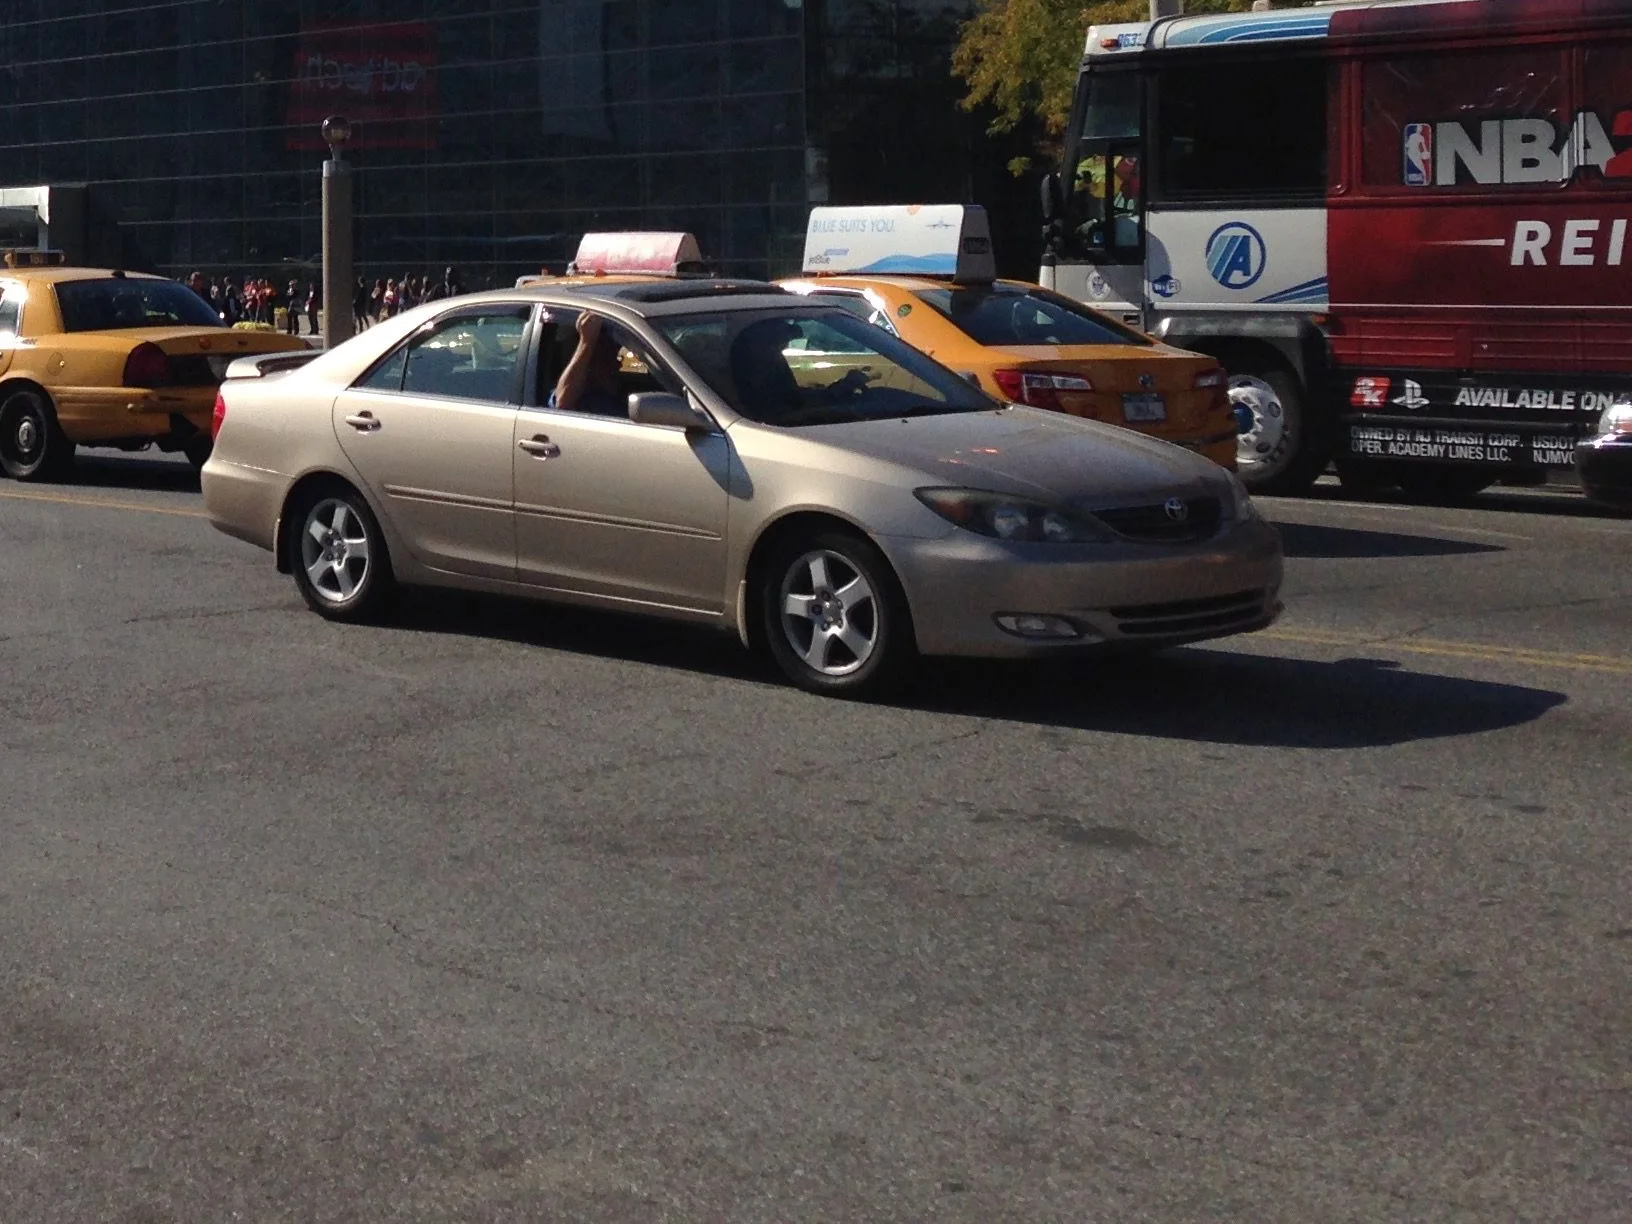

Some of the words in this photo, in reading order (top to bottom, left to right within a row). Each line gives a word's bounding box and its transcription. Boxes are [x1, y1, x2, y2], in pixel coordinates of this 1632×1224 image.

[812, 219, 835, 233] BLUE
[838, 219, 867, 233] SUITS
[871, 219, 896, 233] YOU.
[1454, 387, 1575, 411] AVAILABLE
[1580, 391, 1614, 411] ON
[1351, 426, 1394, 441] OWNED
[1396, 428, 1411, 442] BY
[1415, 429, 1432, 443] NJ
[1434, 431, 1485, 446] TRANSIT
[1488, 433, 1524, 448] CORP.
[1532, 435, 1574, 450] USDOT
[1351, 439, 1385, 454] OPER.
[1388, 442, 1445, 458] ACADEMY
[1448, 445, 1484, 460] LINES
[1486, 447, 1512, 462] LLC.
